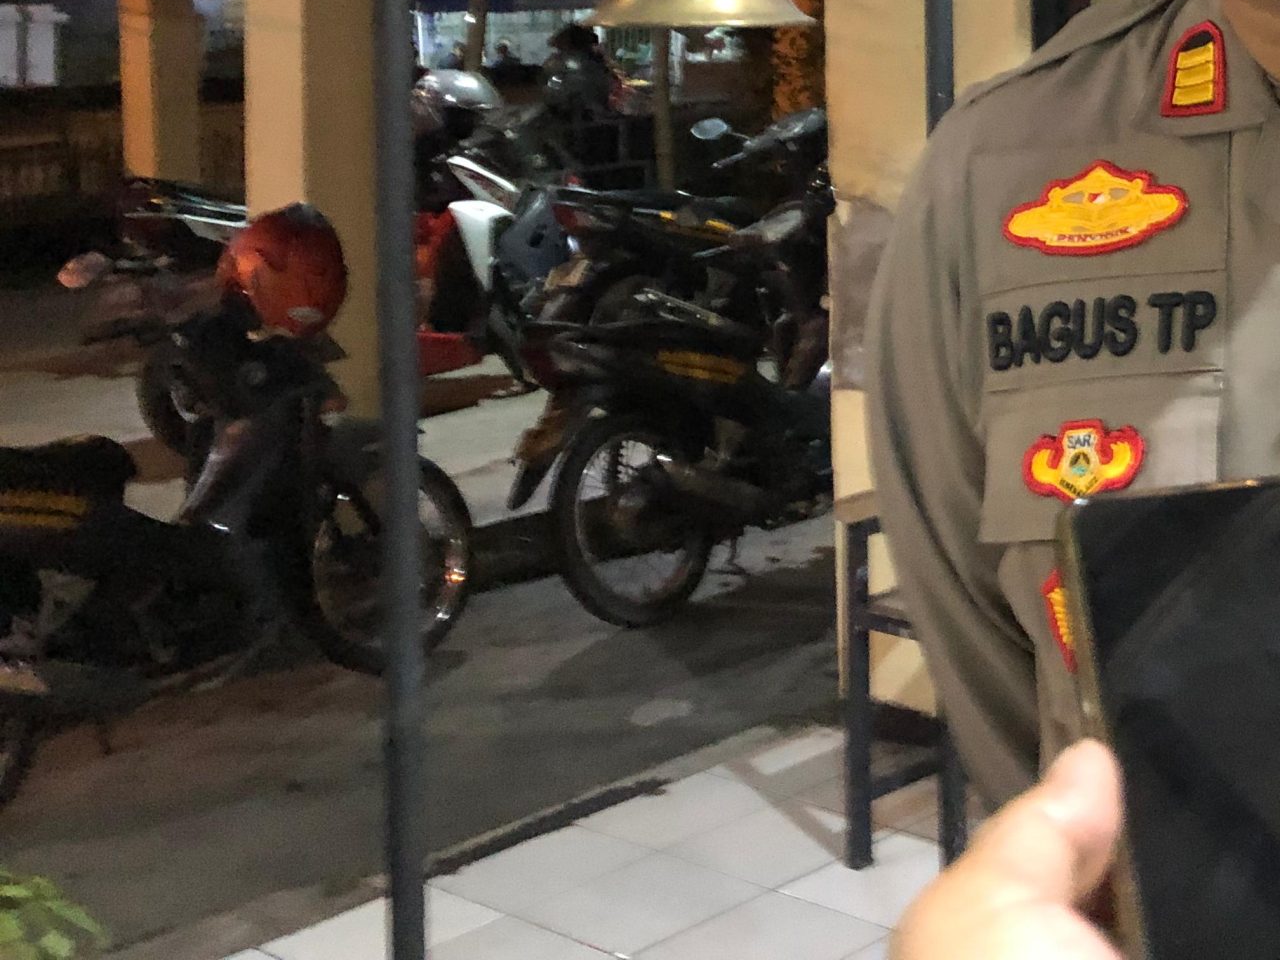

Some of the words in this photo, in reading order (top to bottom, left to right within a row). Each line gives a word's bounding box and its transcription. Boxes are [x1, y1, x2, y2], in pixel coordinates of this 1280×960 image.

[986, 294, 1139, 372] BAGUS
[1147, 290, 1217, 355] TP
[1066, 433, 1092, 450] SAR
